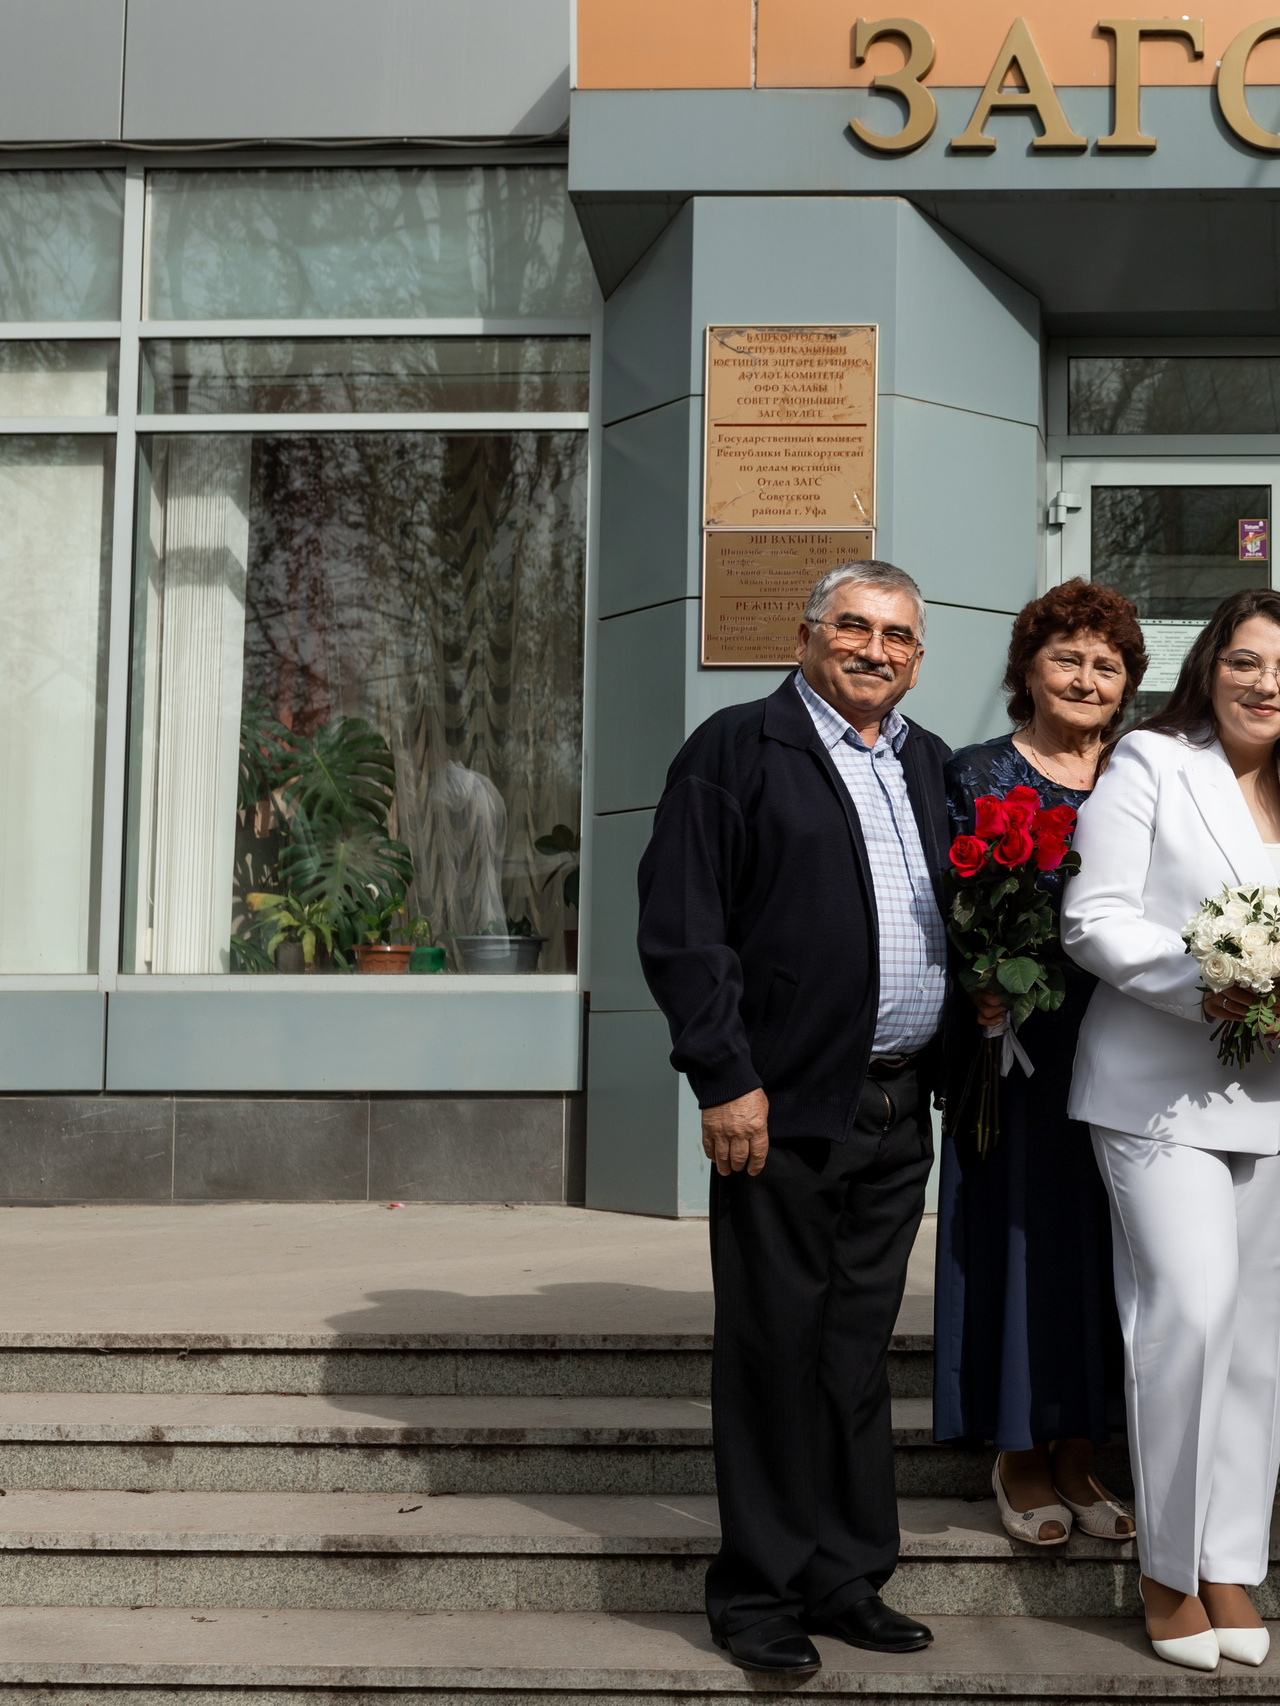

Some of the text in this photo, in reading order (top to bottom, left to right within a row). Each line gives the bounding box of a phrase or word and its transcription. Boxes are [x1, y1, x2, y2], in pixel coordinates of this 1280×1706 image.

[785, 371, 844, 380] КОМИТЕТЫ
[754, 384, 779, 392] ӨФӨ
[737, 397, 770, 405] СОВЕТ
[758, 410, 782, 418] ЗАГС
[718, 434, 863, 445] Государственный комитет
[717, 448, 864, 460] Республики Башкортостан
[756, 465, 788, 473] делам
[791, 465, 841, 473] юстиции
[757, 477, 823, 487] Отдел ЗАГС
[758, 492, 820, 501] Советского
[752, 507, 792, 517] района
[805, 507, 827, 518] Уфа
[748, 535, 767, 544] ЭШ
[735, 601, 782, 611] РЕЖИМ
[720, 614, 757, 623] Вторник
[764, 614, 796, 623] суббота
